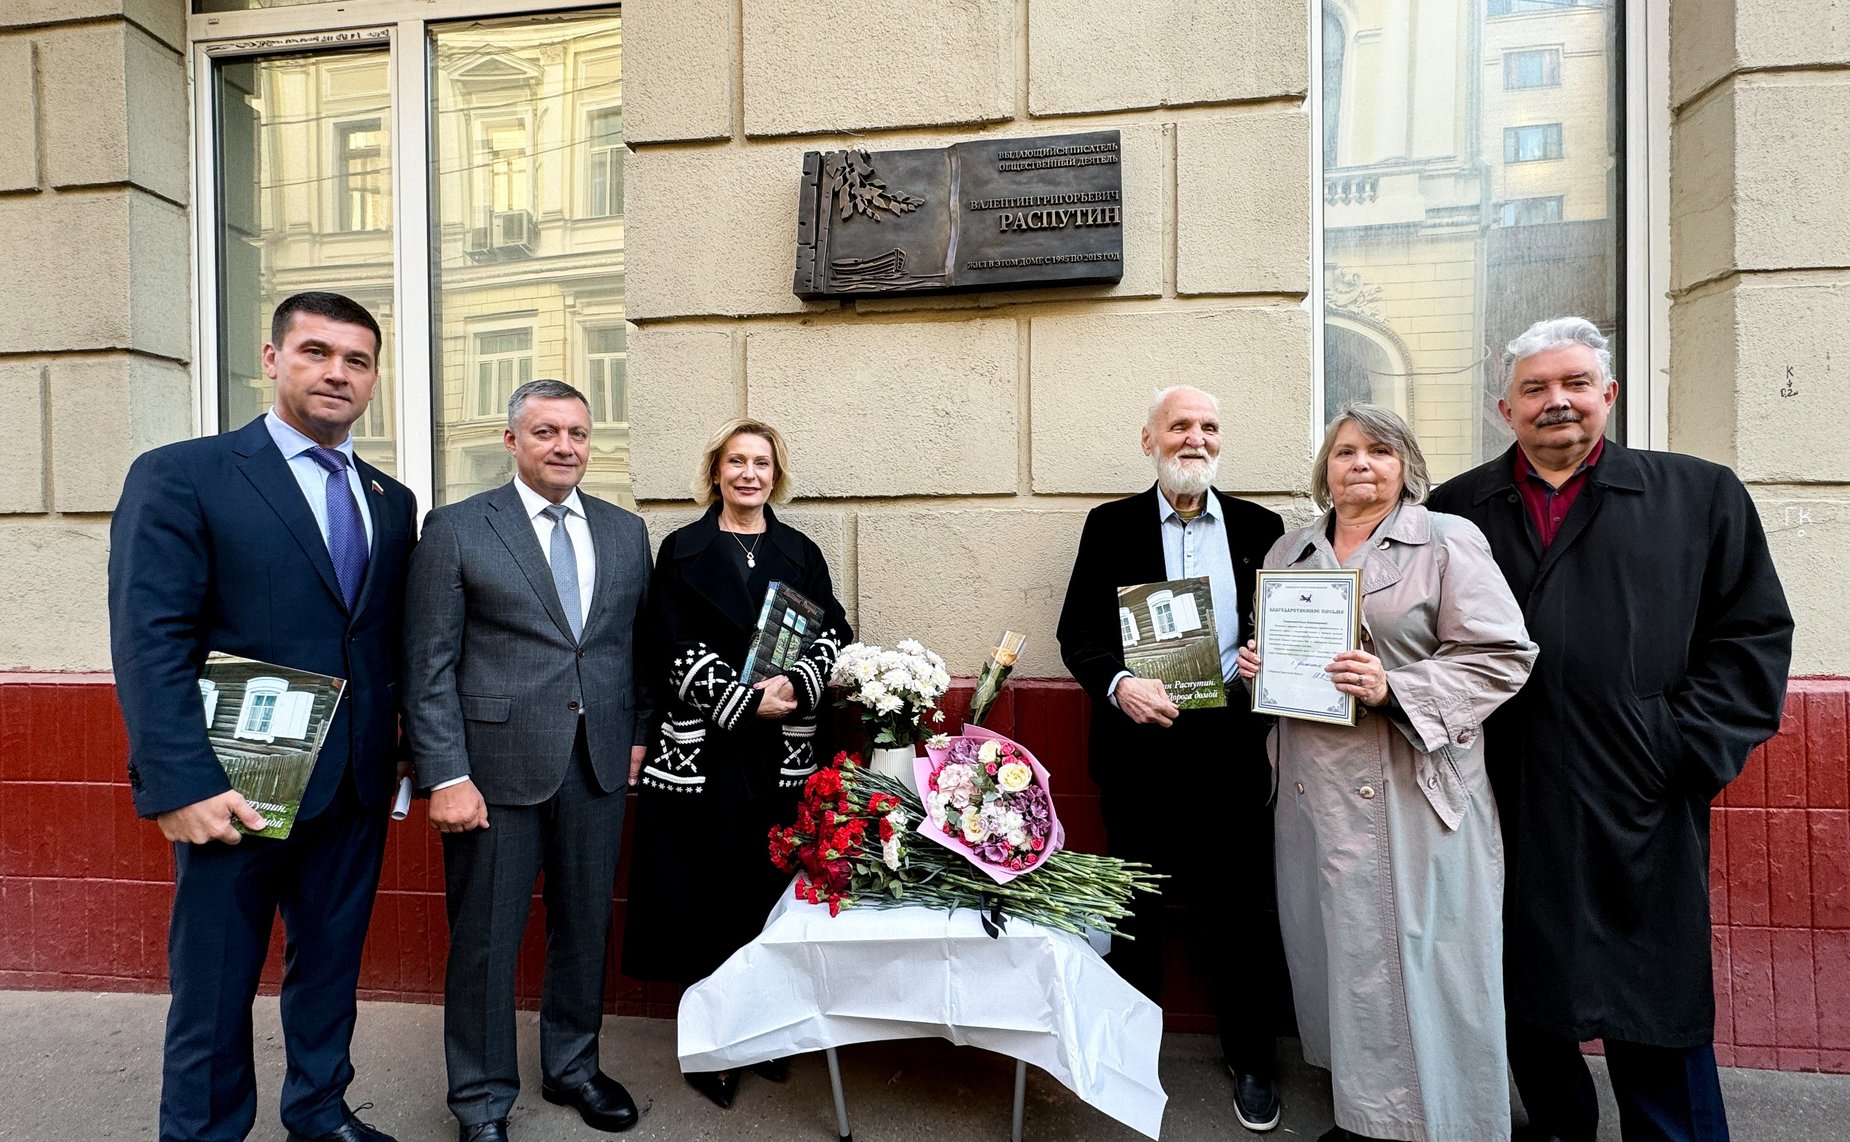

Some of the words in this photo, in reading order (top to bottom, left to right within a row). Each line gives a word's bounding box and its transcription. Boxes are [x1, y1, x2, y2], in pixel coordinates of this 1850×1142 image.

[999, 146, 1068, 159] ВЫДАЮЩИЙСЯ
[1070, 143, 1118, 154] ПИСАТЕЛЬ
[999, 157, 1076, 171] ОБЩЕСТВЕННЫЙ
[1077, 155, 1118, 167] ДЕЯТЕЛЬ
[970, 195, 1033, 210] ВАЛЕНТИН
[1036, 190, 1119, 205] ГРИГОРЬЕВИЧ
[1000, 206, 1121, 231] РАСПУТИН
[988, 260, 994, 268] В
[995, 259, 1018, 267] ЭТОМ
[1019, 256, 1044, 266] ДОМЕ
[1045, 256, 1051, 264] С
[1070, 254, 1083, 262] ПО
[1083, 253, 1102, 261] 2015
[1103, 252, 1120, 260] ГОД
[1174, 680, 1216, 690] Распутин.
